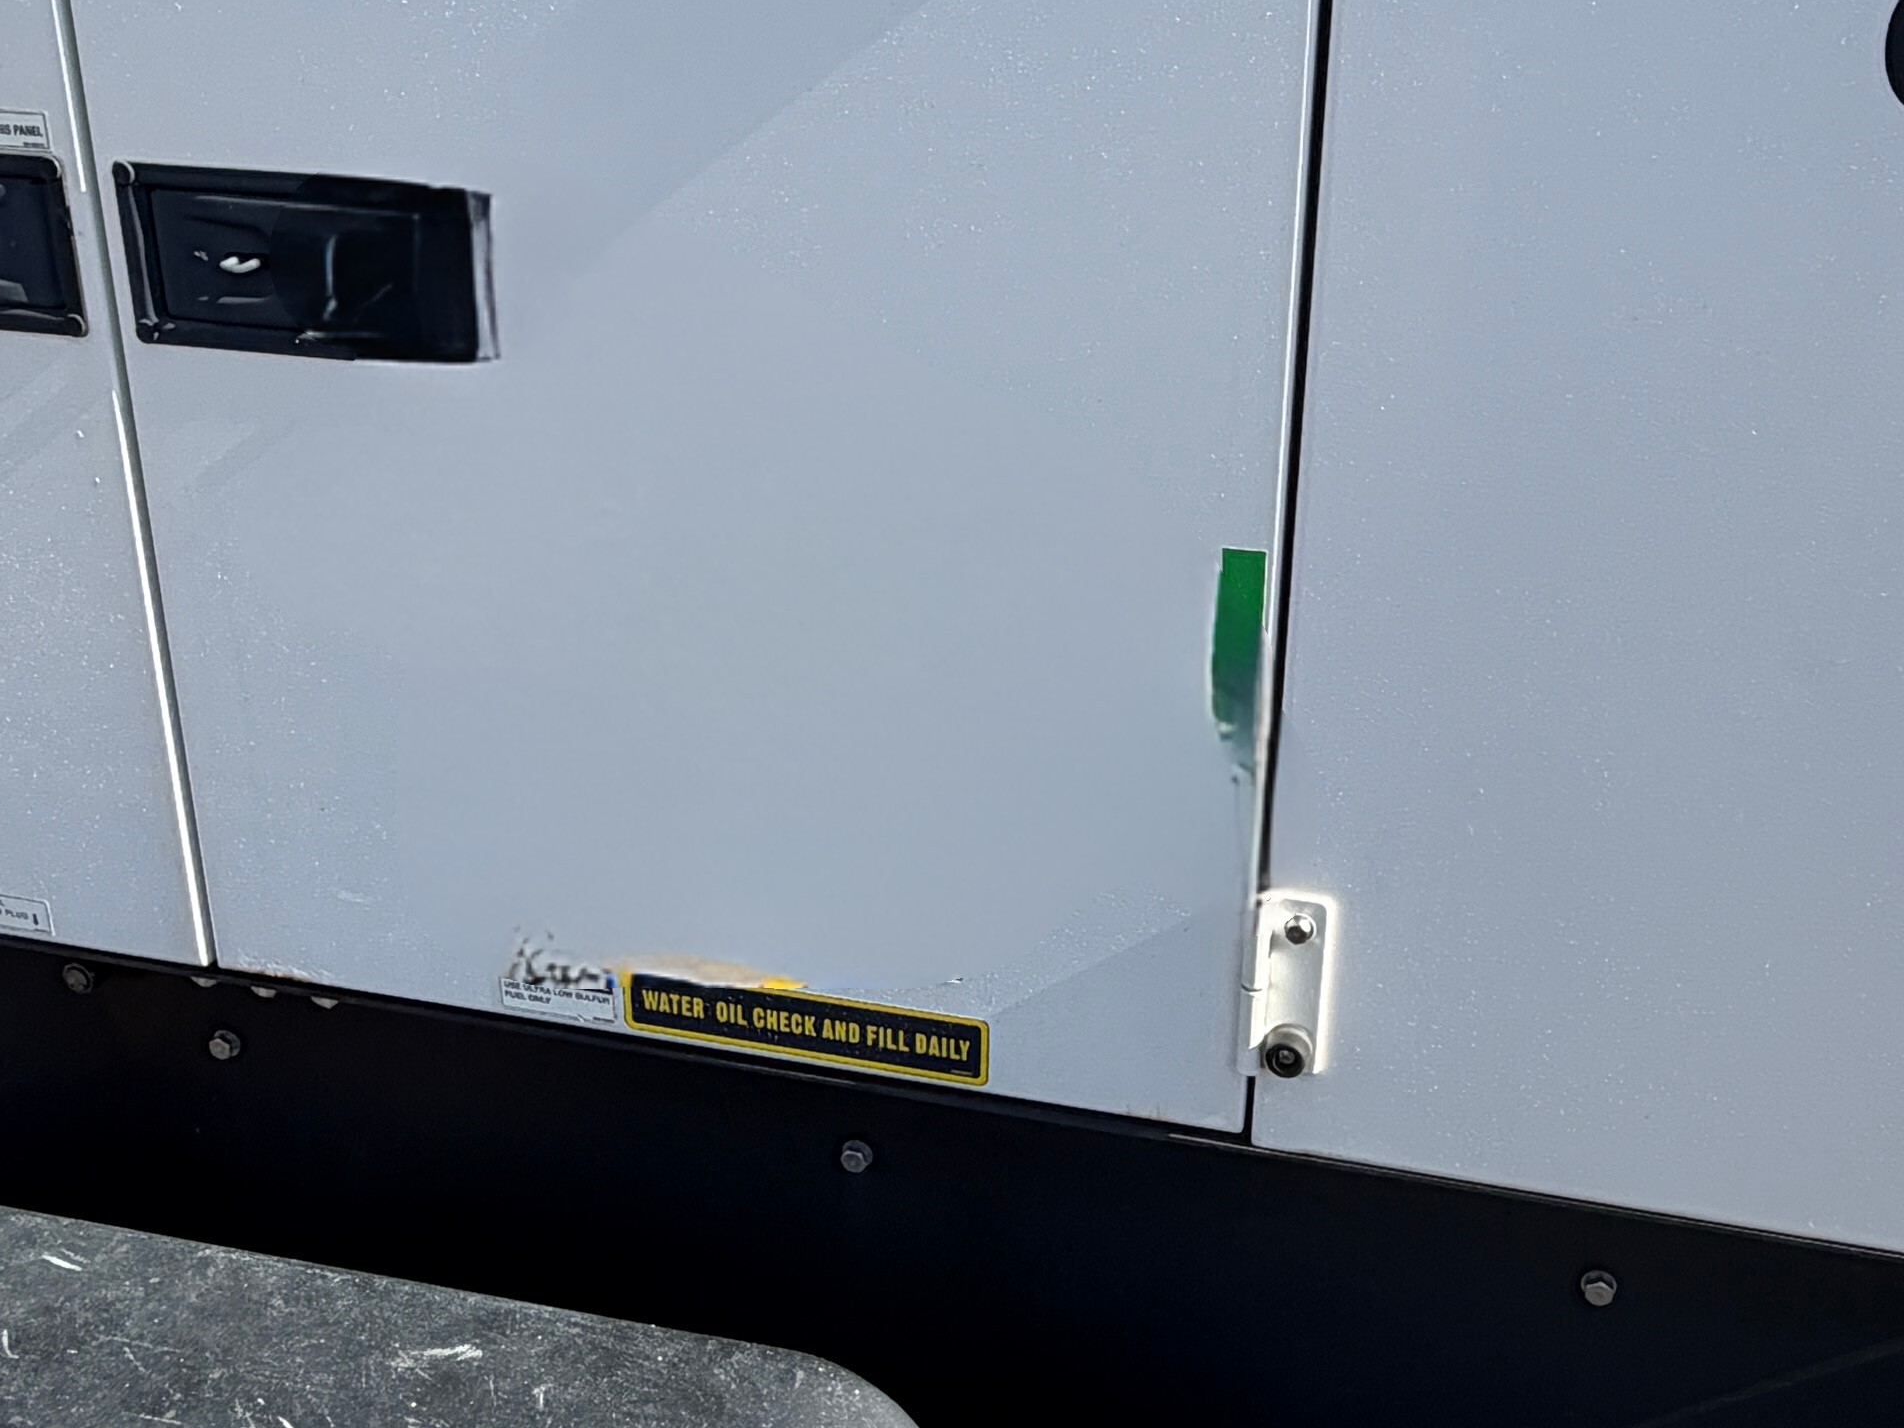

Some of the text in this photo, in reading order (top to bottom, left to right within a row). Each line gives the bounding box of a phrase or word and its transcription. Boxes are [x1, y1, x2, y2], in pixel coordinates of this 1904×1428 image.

[13, 124, 44, 138] PANEL
[503, 980, 521, 990] USE
[522, 983, 552, 995] ULTRA
[504, 990, 552, 1004] FUEL ONLY
[641, 989, 972, 1063] WATER OIL CHECK AND FILL DAILY
